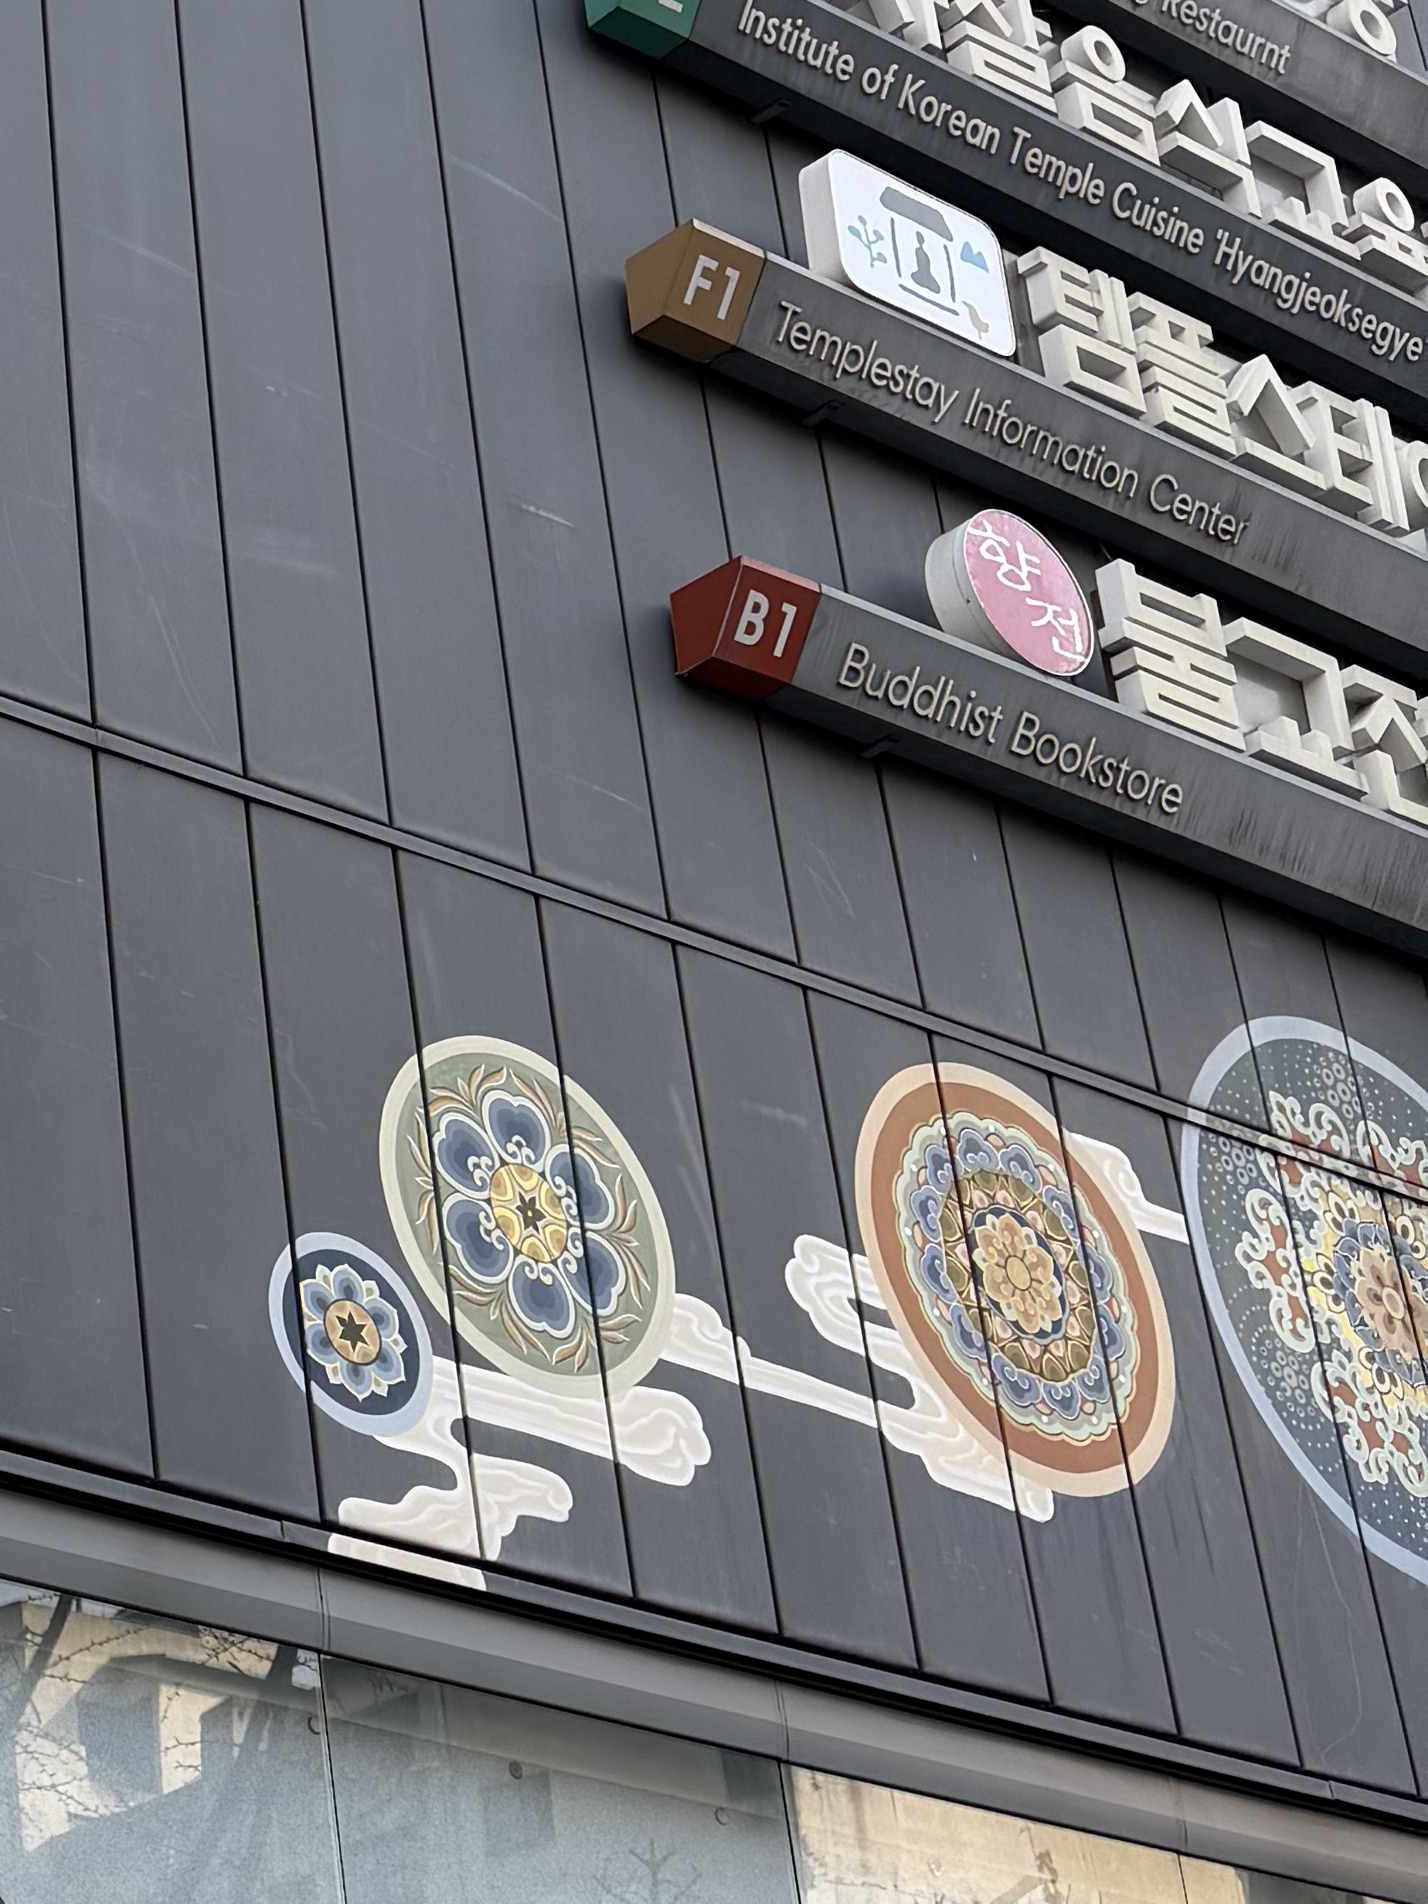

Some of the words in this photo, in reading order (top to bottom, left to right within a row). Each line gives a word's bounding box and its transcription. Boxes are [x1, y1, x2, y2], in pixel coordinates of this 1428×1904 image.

[861, 64, 899, 101] of
[898, 73, 1002, 156] Korean
[1010, 126, 1106, 206] Temple
[1110, 180, 1206, 254] Cuisine
[682, 253, 741, 321] F1
[774, 300, 960, 425] Templestay
[962, 387, 1140, 498] Information
[1149, 473, 1251, 546] Center
[733, 589, 799, 658] B1
[838, 642, 1005, 746] Buddhist
[1010, 709, 1184, 815] Bookstore
